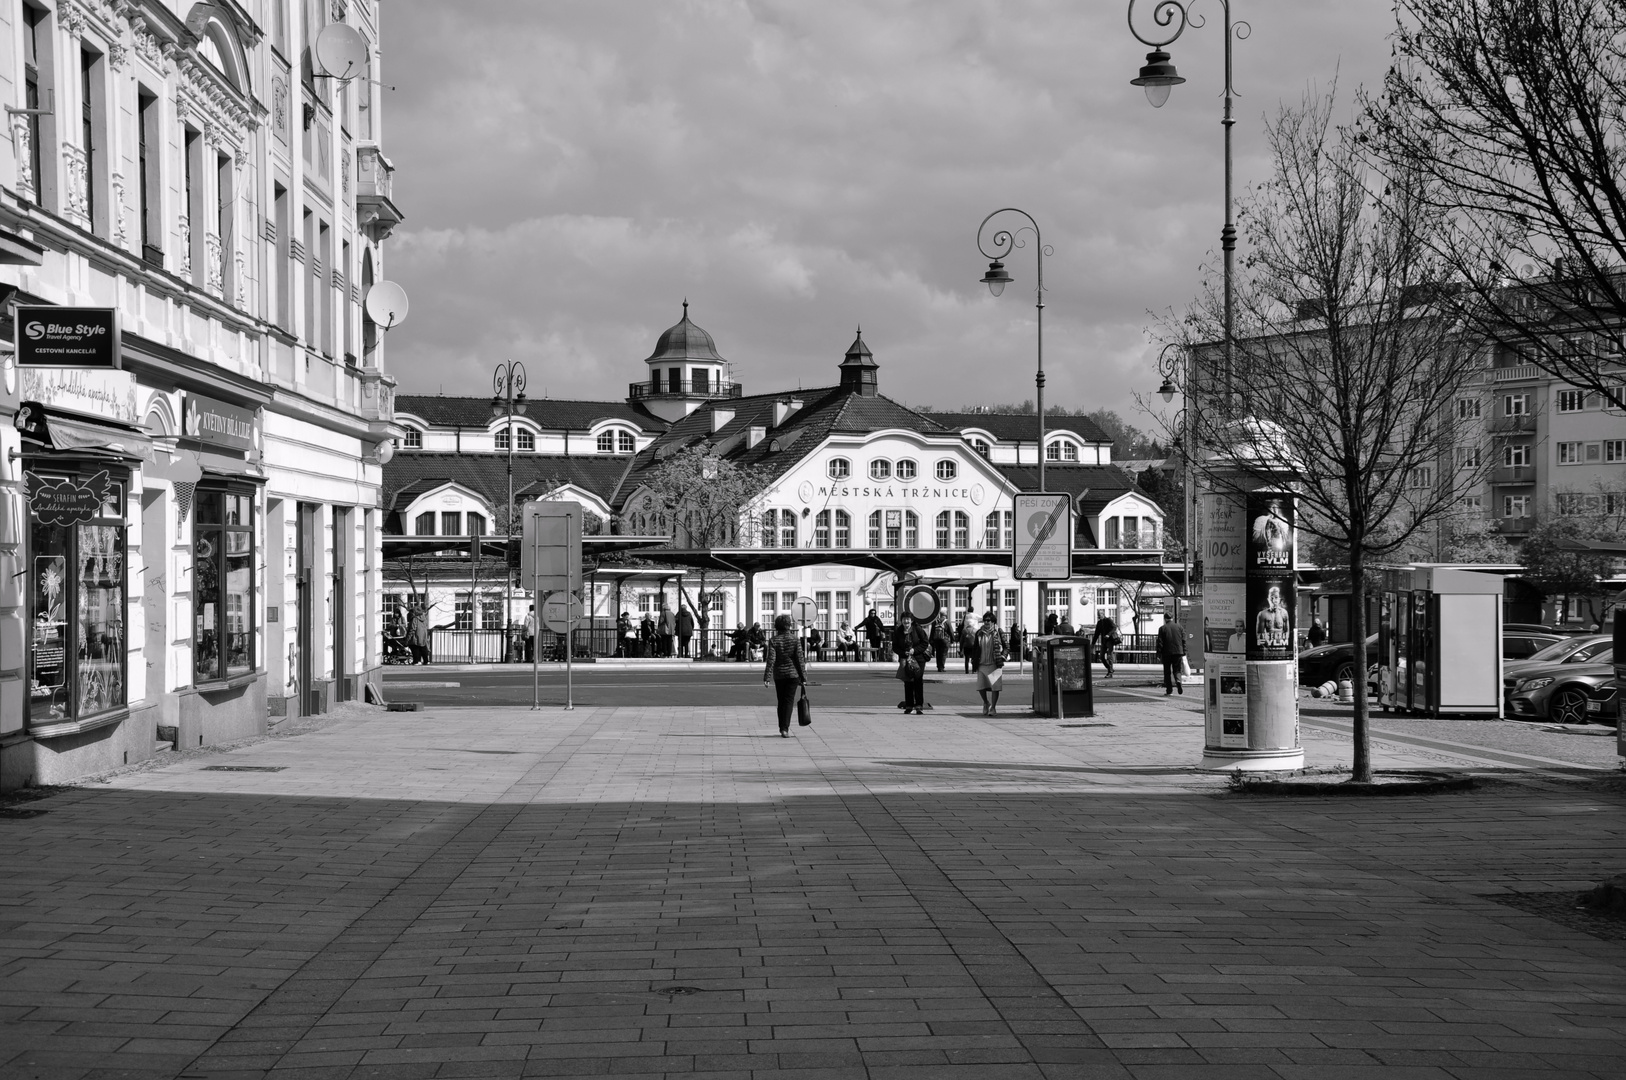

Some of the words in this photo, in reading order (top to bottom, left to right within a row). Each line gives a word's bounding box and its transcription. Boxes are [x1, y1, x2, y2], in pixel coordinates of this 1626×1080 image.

[47, 323, 73, 334] Blue
[75, 324, 106, 337] Style
[203, 409, 227, 433] KVĚTINY
[817, 486, 894, 498] MĚSTSKÁ
[902, 486, 969, 498] TRŽNICE
[53, 493, 77, 503] SERAFIN
[1020, 497, 1038, 508] PĚŠÍ
[1257, 557, 1289, 565] FYLM
[880, 610, 895, 619] alb
